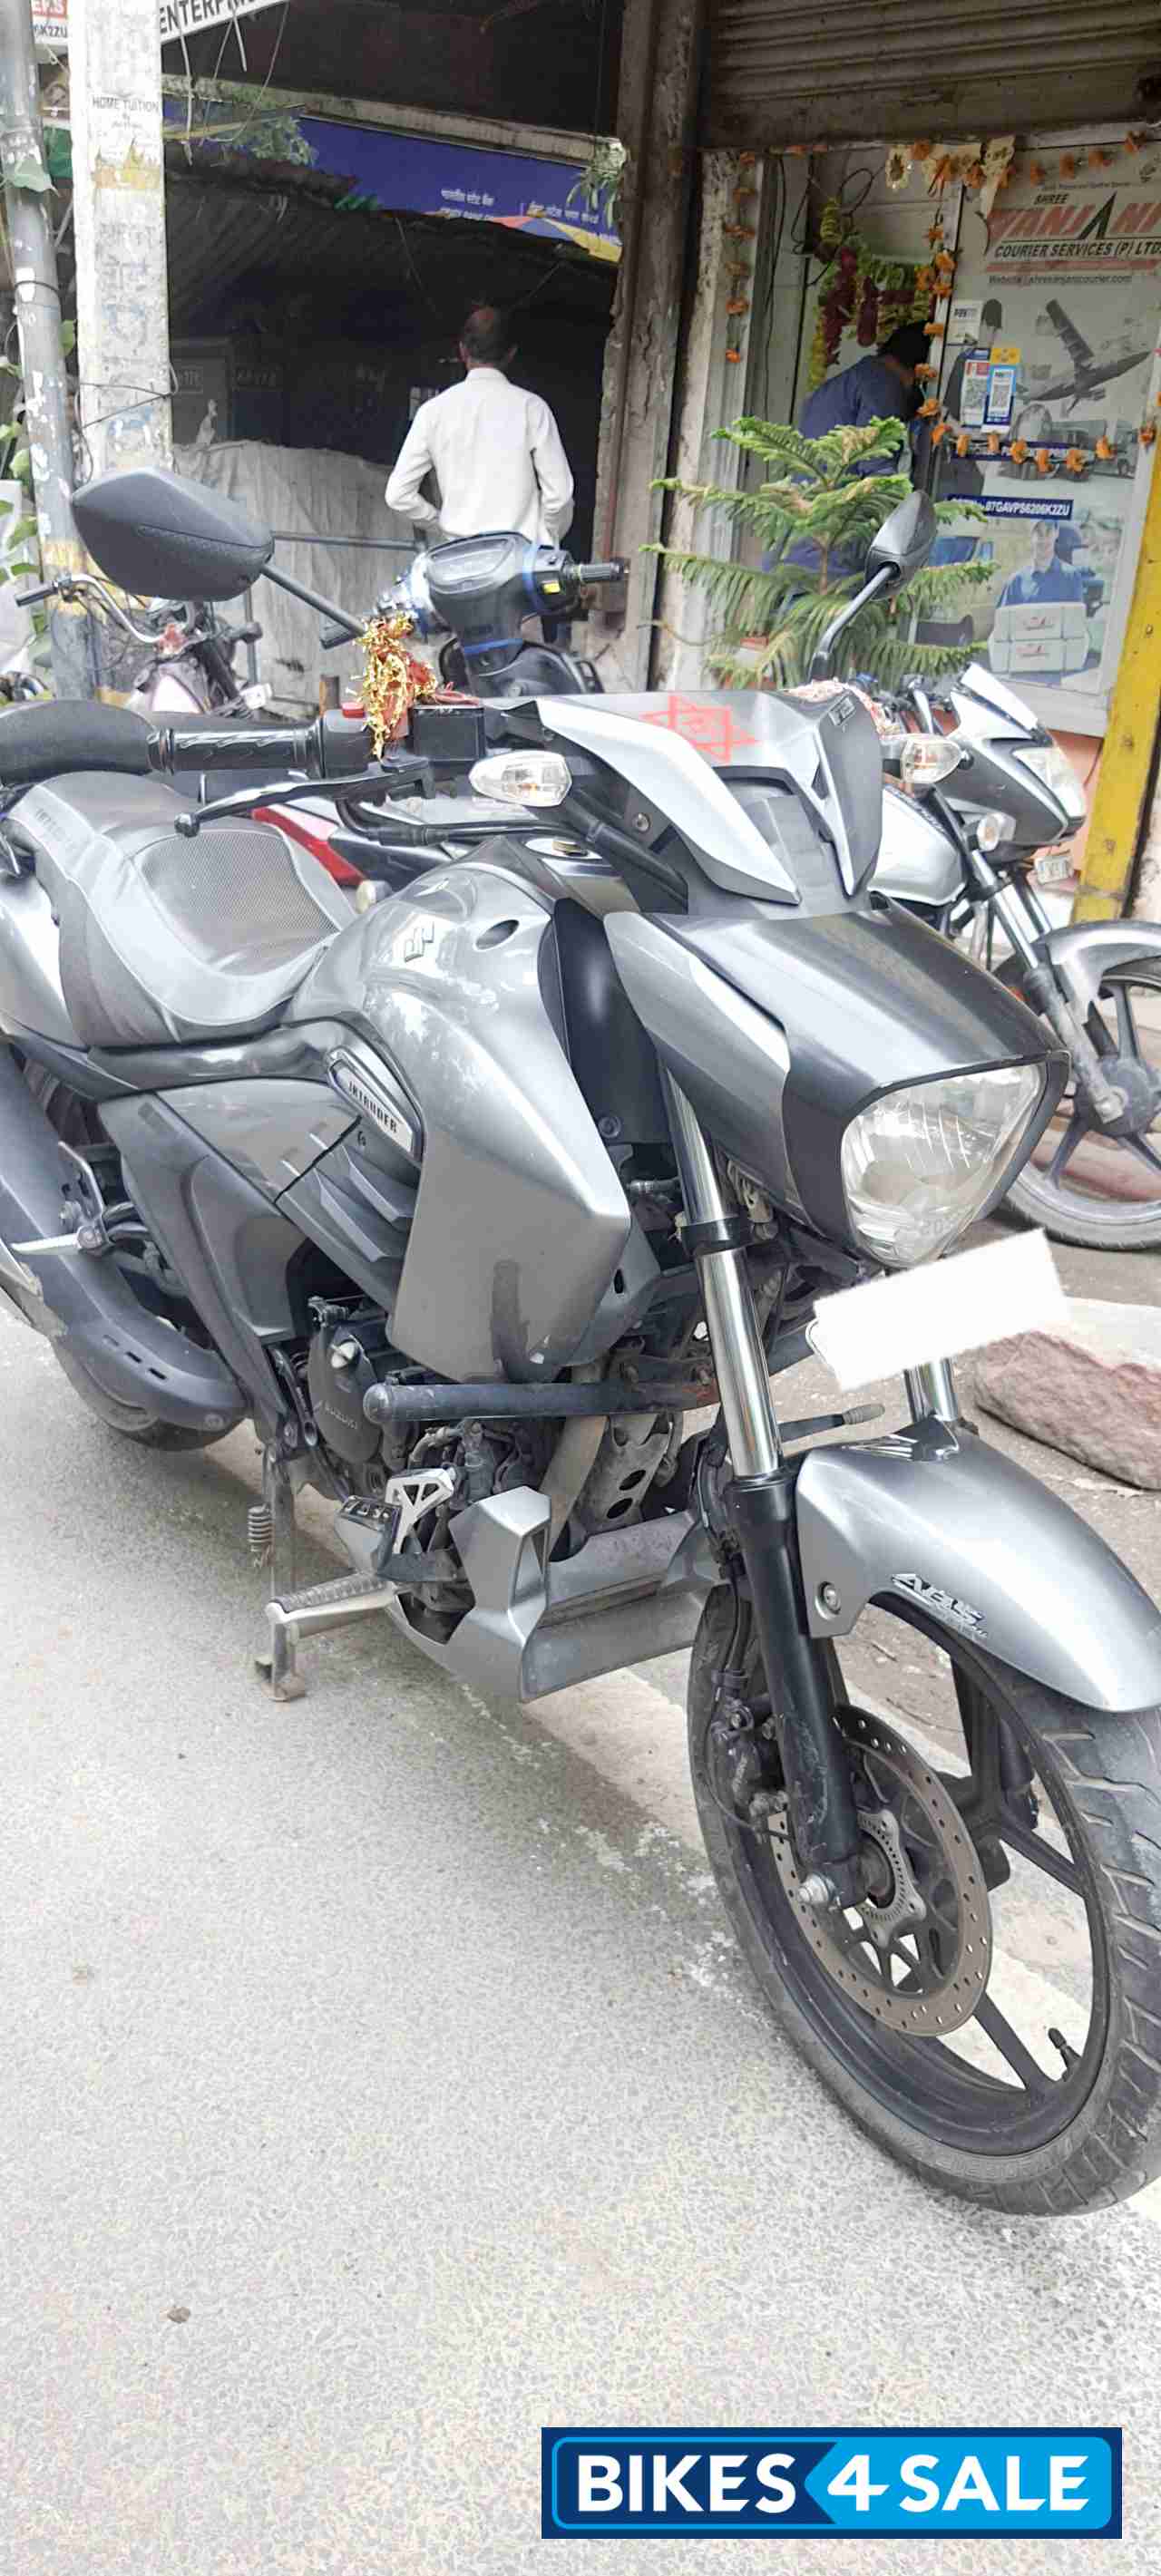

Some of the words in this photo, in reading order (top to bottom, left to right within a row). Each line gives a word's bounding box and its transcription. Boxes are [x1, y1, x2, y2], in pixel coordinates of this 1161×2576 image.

[93, 96, 119, 110] HOME
[1033, 193, 1069, 205] SHREE
[994, 244, 1048, 258] COURIER
[1049, 241, 1112, 256] SERVICES
[1113, 241, 1134, 256] (P)
[348, 1079, 398, 1133] INTRUDER
[891, 1573, 986, 1628] ABS
